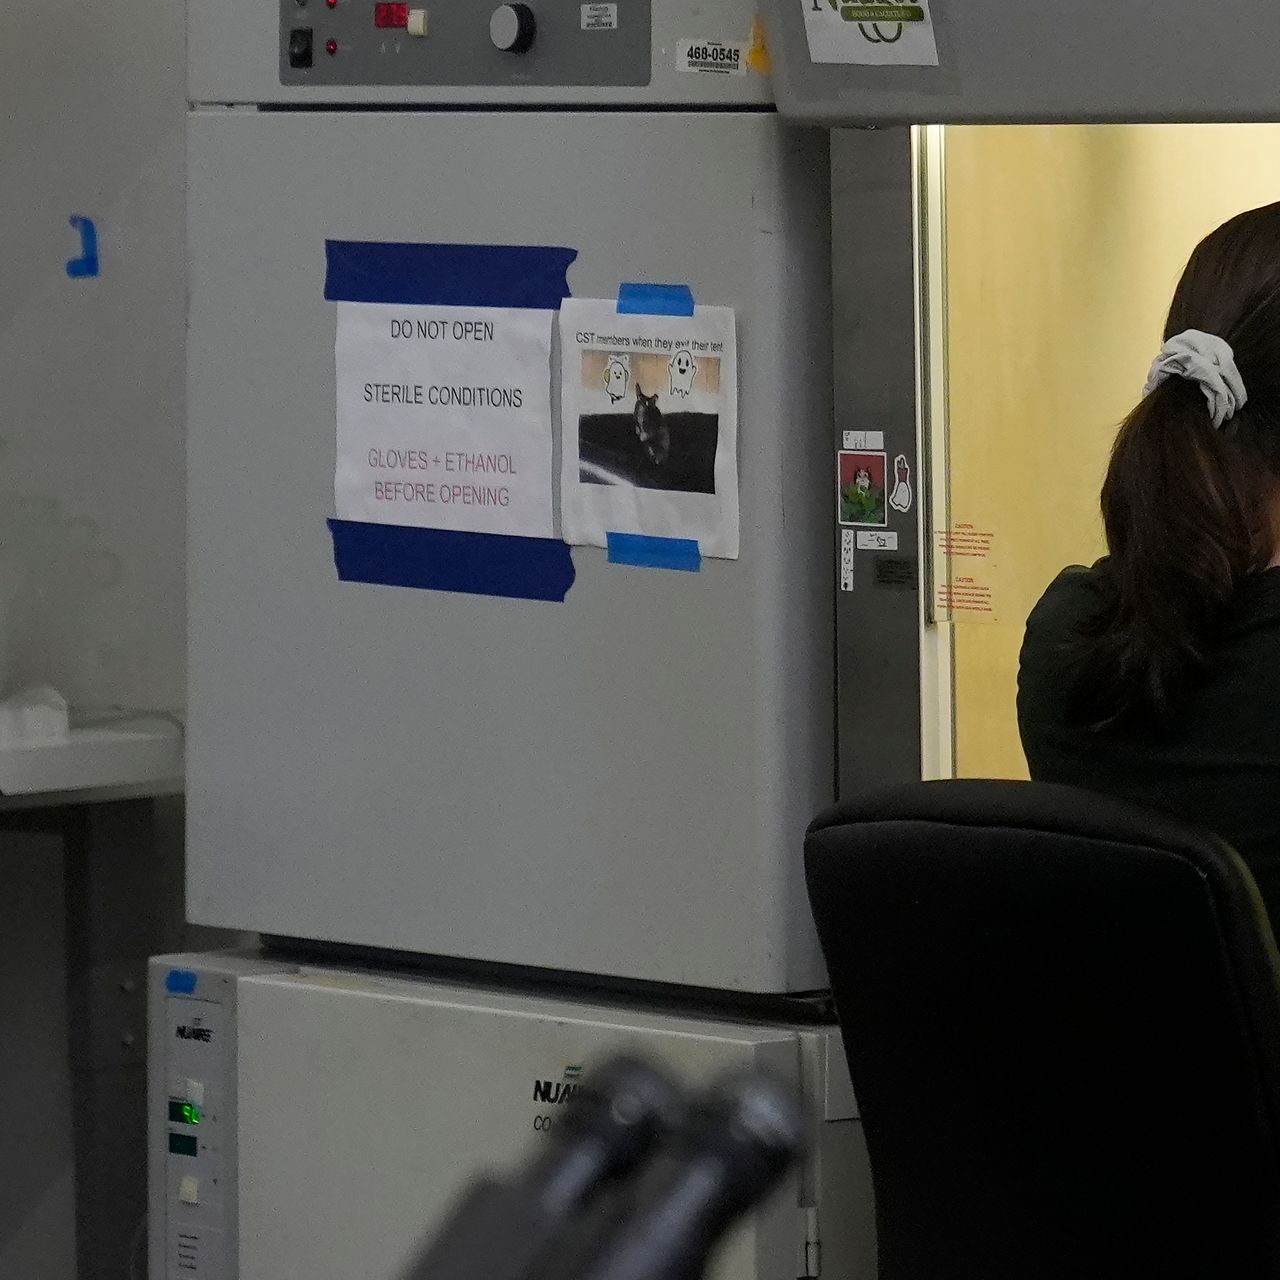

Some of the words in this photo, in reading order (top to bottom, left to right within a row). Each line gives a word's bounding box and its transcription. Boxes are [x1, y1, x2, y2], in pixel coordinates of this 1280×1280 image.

[687, 45, 740, 63] 468-0545
[390, 319, 414, 340] DO
[416, 320, 449, 340] NOT
[452, 320, 495, 342] OPEN
[575, 331, 596, 344] CST
[596, 334, 631, 346] members
[632, 337, 653, 348] when
[654, 338, 673, 352] they
[691, 340, 709, 351] their
[363, 384, 424, 406] STERILE
[428, 385, 524, 409] CONDITIONS
[367, 449, 429, 471] GLOVES
[432, 456, 442, 468] +
[445, 452, 517, 475] ETHANOL
[374, 481, 436, 502] BEFORE
[439, 484, 511, 507] OPENING
